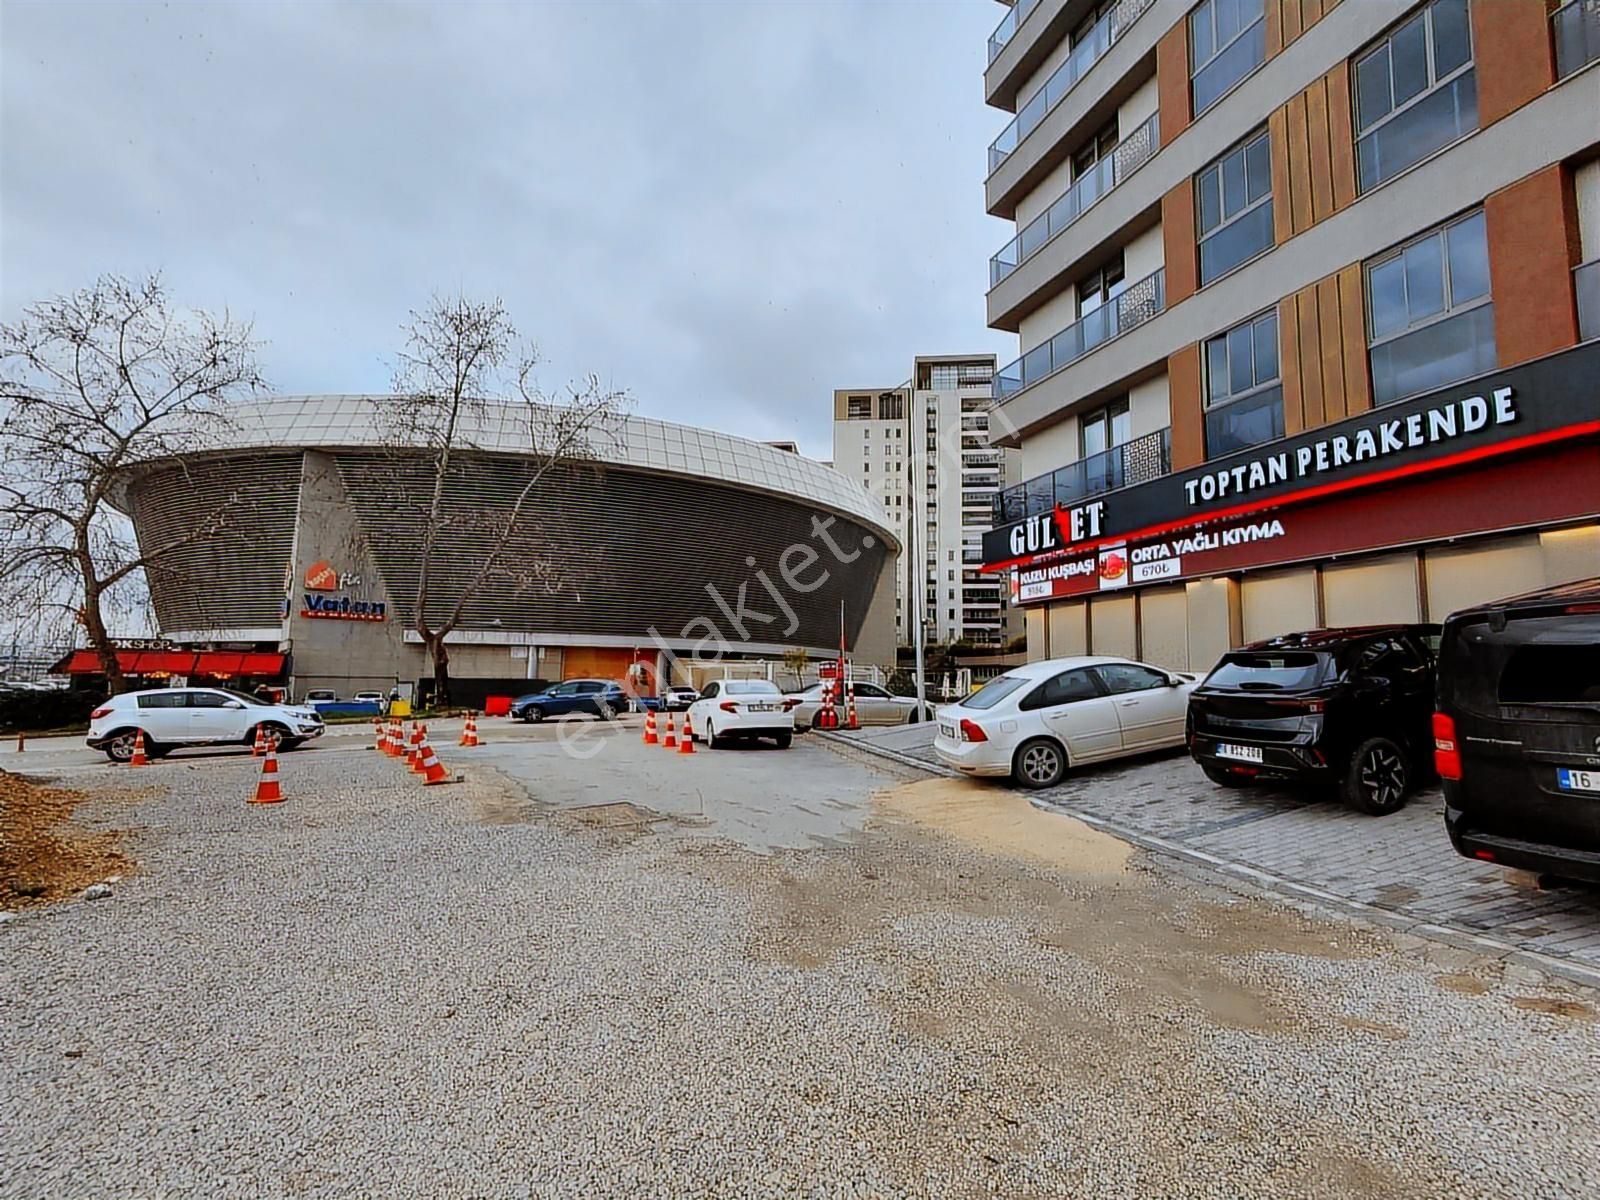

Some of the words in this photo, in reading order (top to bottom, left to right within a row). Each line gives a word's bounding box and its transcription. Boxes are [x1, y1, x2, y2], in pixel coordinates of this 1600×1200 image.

[1185, 453, 1287, 505] TOPTAN
[1296, 387, 1516, 476] PERAKENDE
[1010, 515, 1055, 556] GÜL
[1070, 501, 1104, 541] ET
[1131, 545, 1170, 563] ORTA
[1172, 532, 1219, 556] YAĞLI
[1222, 520, 1285, 546] KIYMA
[1020, 568, 1047, 585] KUZU
[1048, 558, 1095, 580] KUŞBAŞI
[304, 592, 385, 614] Vatan
[1572, 771, 1592, 788] 16
